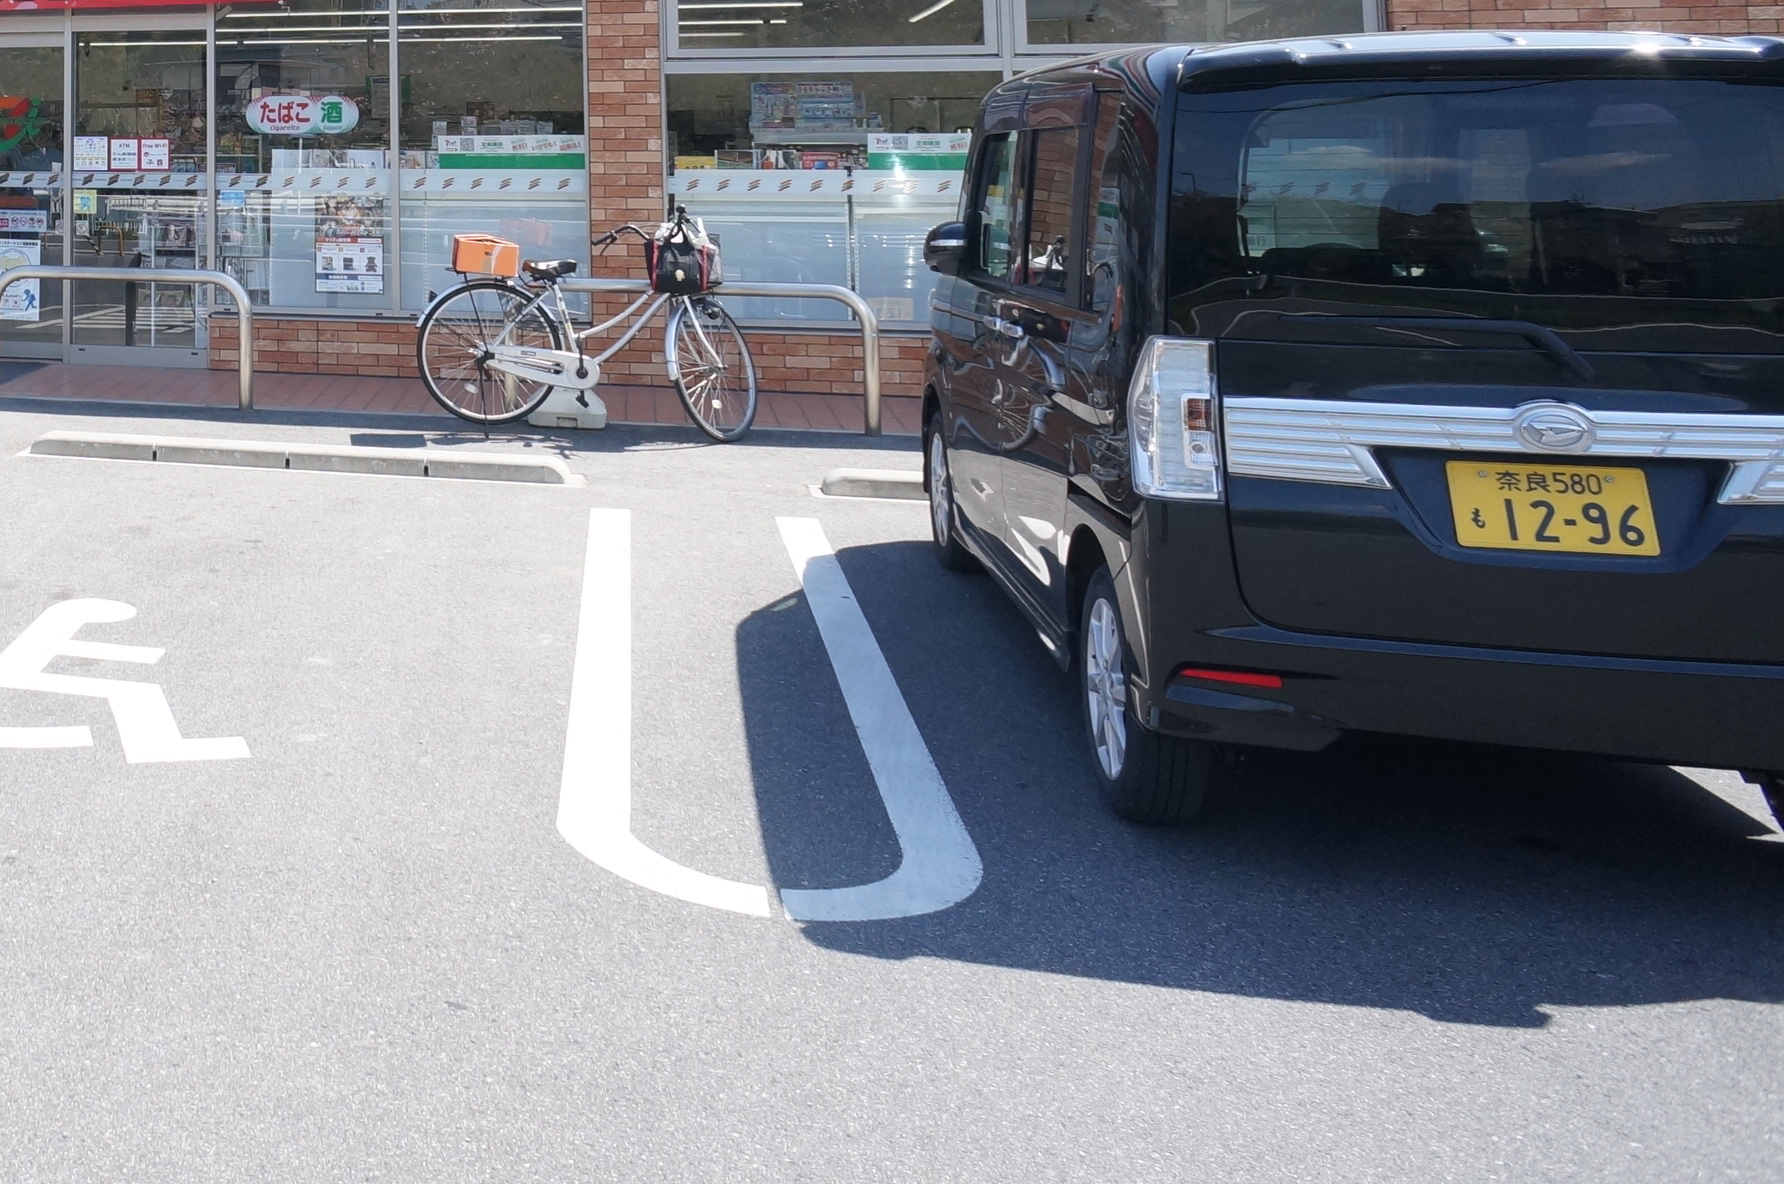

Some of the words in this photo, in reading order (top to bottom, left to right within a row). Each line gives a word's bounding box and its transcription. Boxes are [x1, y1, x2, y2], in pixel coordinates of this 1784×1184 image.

[260, 101, 311, 124] たばこ
[321, 101, 343, 123] 酒
[1495, 470, 1603, 496] 奈良580
[1470, 507, 1486, 529] も
[1503, 498, 1646, 547] 12-96
